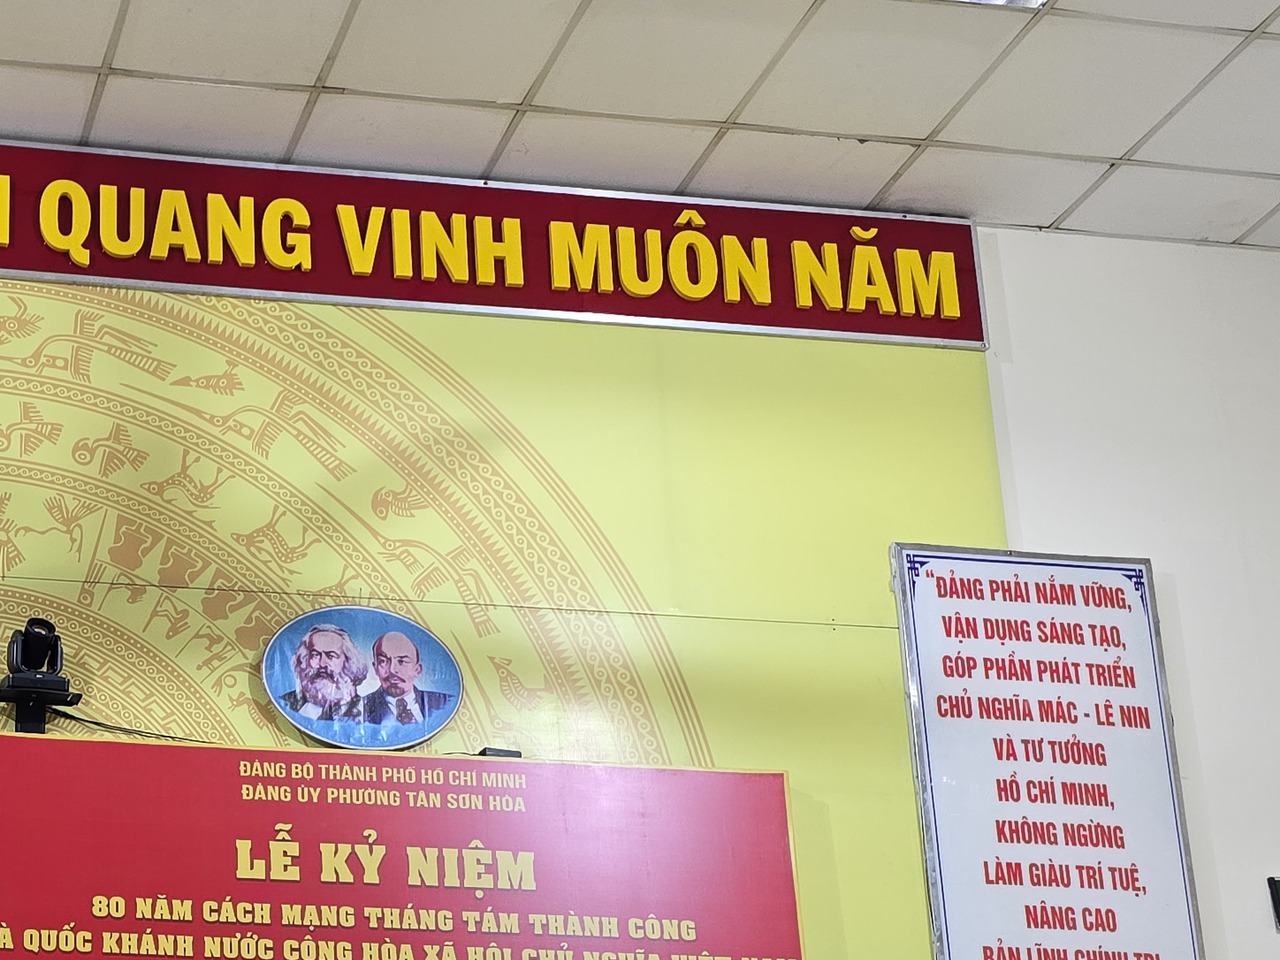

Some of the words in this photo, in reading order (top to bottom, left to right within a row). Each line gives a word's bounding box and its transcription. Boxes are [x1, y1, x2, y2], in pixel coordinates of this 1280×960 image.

[40, 180, 311, 271] QUANG
[336, 205, 523, 287] VINH
[549, 210, 771, 304] MUÔN
[791, 227, 960, 318] NĂM
[989, 573, 1030, 604] PHẢI
[1035, 574, 1075, 606] NẮM
[1079, 581, 1133, 614] VỮNG,
[941, 611, 979, 644] VẬN
[983, 617, 1032, 647] DỤNG
[1037, 616, 1085, 646] SÁNG
[1088, 624, 1127, 652] TẠO,
[942, 650, 977, 679] GÓP
[983, 650, 1033, 683] PHẦN
[1037, 657, 1081, 685] PHÁT
[1085, 655, 1136, 689] TRIỂN
[936, 688, 973, 719] CHỦ
[977, 694, 1034, 723] NGHĨA
[1037, 696, 1079, 725] MÁC
[1094, 700, 1116, 727] LÊ
[1119, 704, 1151, 730] NIN
[992, 733, 1018, 762] VÀ
[1020, 737, 1044, 763] TƯ
[1048, 733, 1107, 767] TƯỞNG
[291, 762, 314, 781] BỘ
[318, 763, 377, 781] THÀNH
[382, 765, 416, 784] PHỐ
[448, 769, 477, 786] CHÍ
[482, 772, 527, 789] MINH
[996, 771, 1021, 803] HỒ
[1026, 775, 1057, 805] CHÍ
[1061, 780, 1115, 811] MINH,
[326, 786, 401, 806] PHƯỜNG
[405, 790, 441, 808] TÂN
[446, 793, 483, 810] SƠN
[489, 794, 526, 812] HÒA
[995, 816, 1058, 846] KHÔNG
[1062, 819, 1126, 850] NGỪNG
[235, 823, 301, 882] LỄ
[320, 829, 386, 884] KỶ
[406, 839, 536, 899] NIỆM
[91, 896, 126, 918] 80
[135, 894, 193, 921] NĂM
[202, 897, 271, 925] CÁCH
[281, 904, 356, 931] MẠNG
[363, 903, 454, 932] THÁNG
[462, 907, 520, 934] TÁM
[528, 910, 619, 938] THÀNH
[628, 913, 697, 941] CÔNG
[1024, 900, 1077, 931] NÂNG
[1081, 907, 1118, 933] CAO
[23, 922, 92, 954] QUỐC
[101, 928, 194, 958] KHÁNH
[203, 932, 275, 960] NƯỚC
